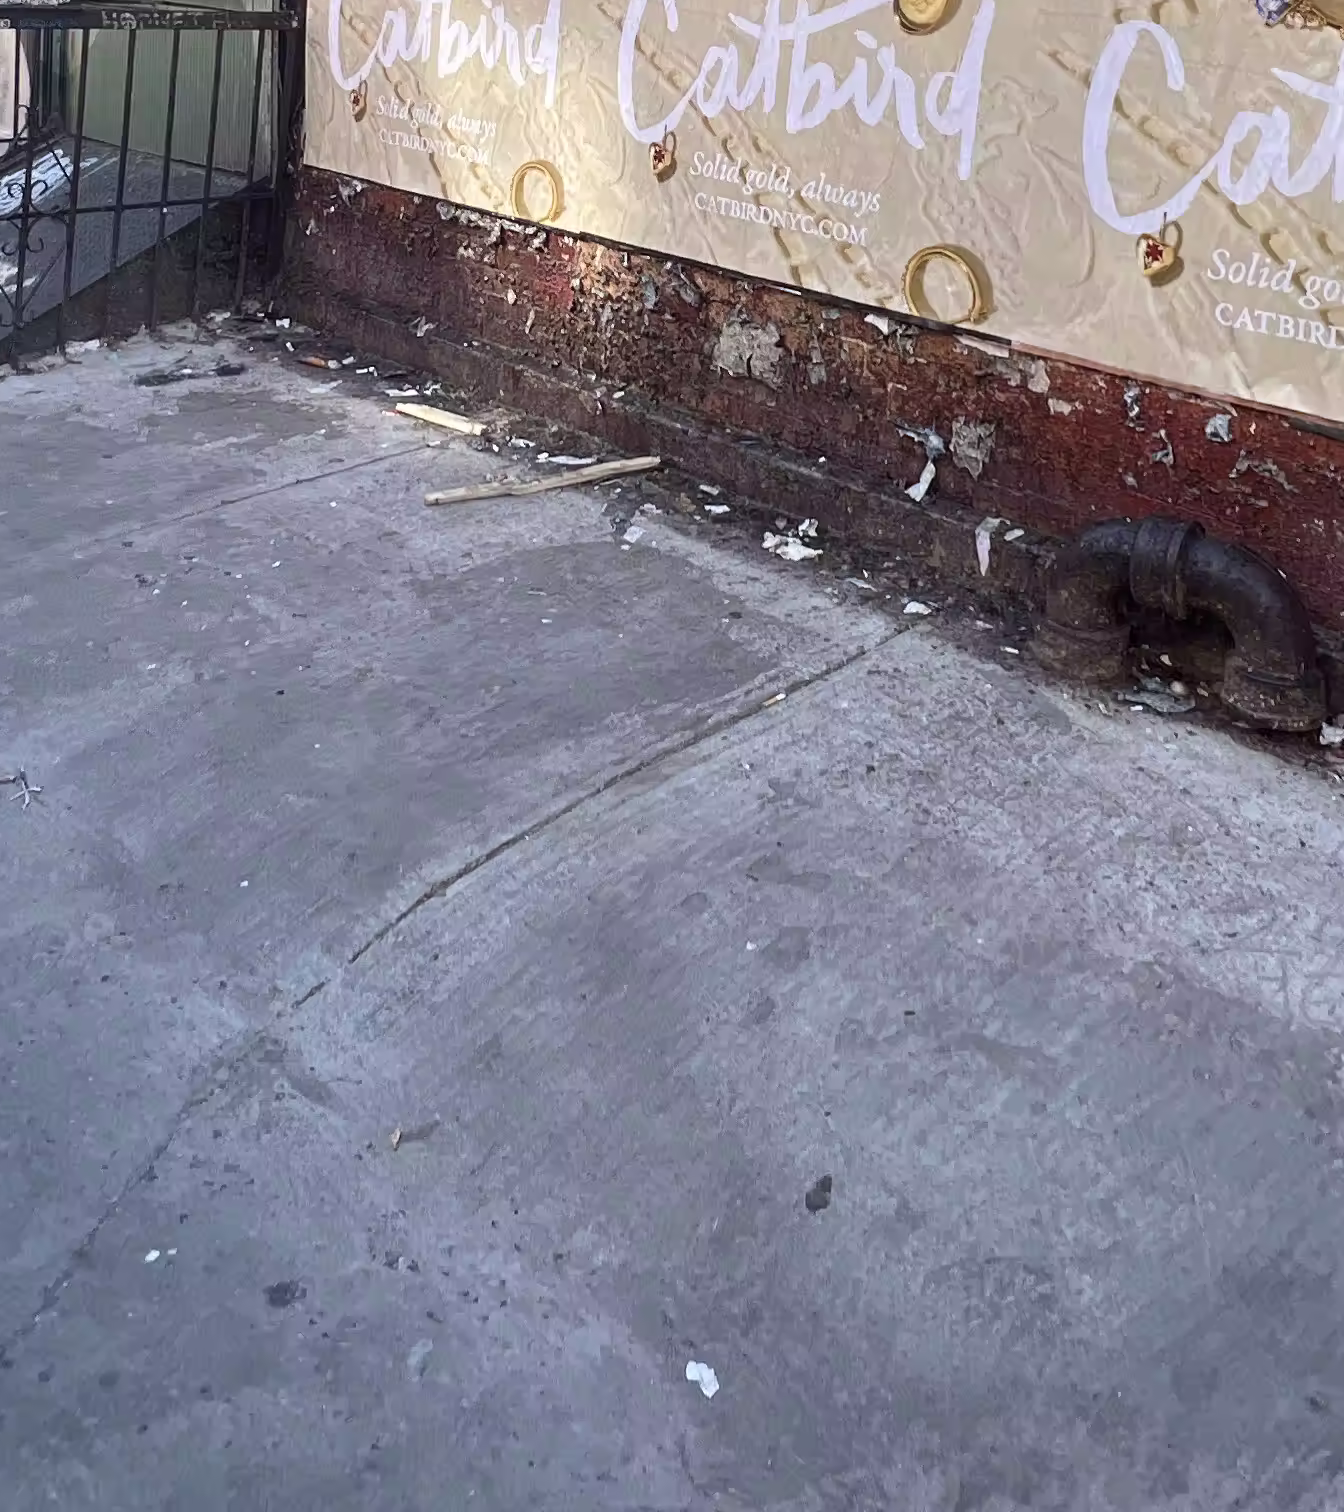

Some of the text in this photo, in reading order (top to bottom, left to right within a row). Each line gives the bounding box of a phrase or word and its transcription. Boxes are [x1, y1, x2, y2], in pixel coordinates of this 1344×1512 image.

[689, 151, 881, 218] Solid gold, always
[694, 192, 868, 246] CATBIRDNYC.COM
[1207, 248, 1298, 294] Solid
